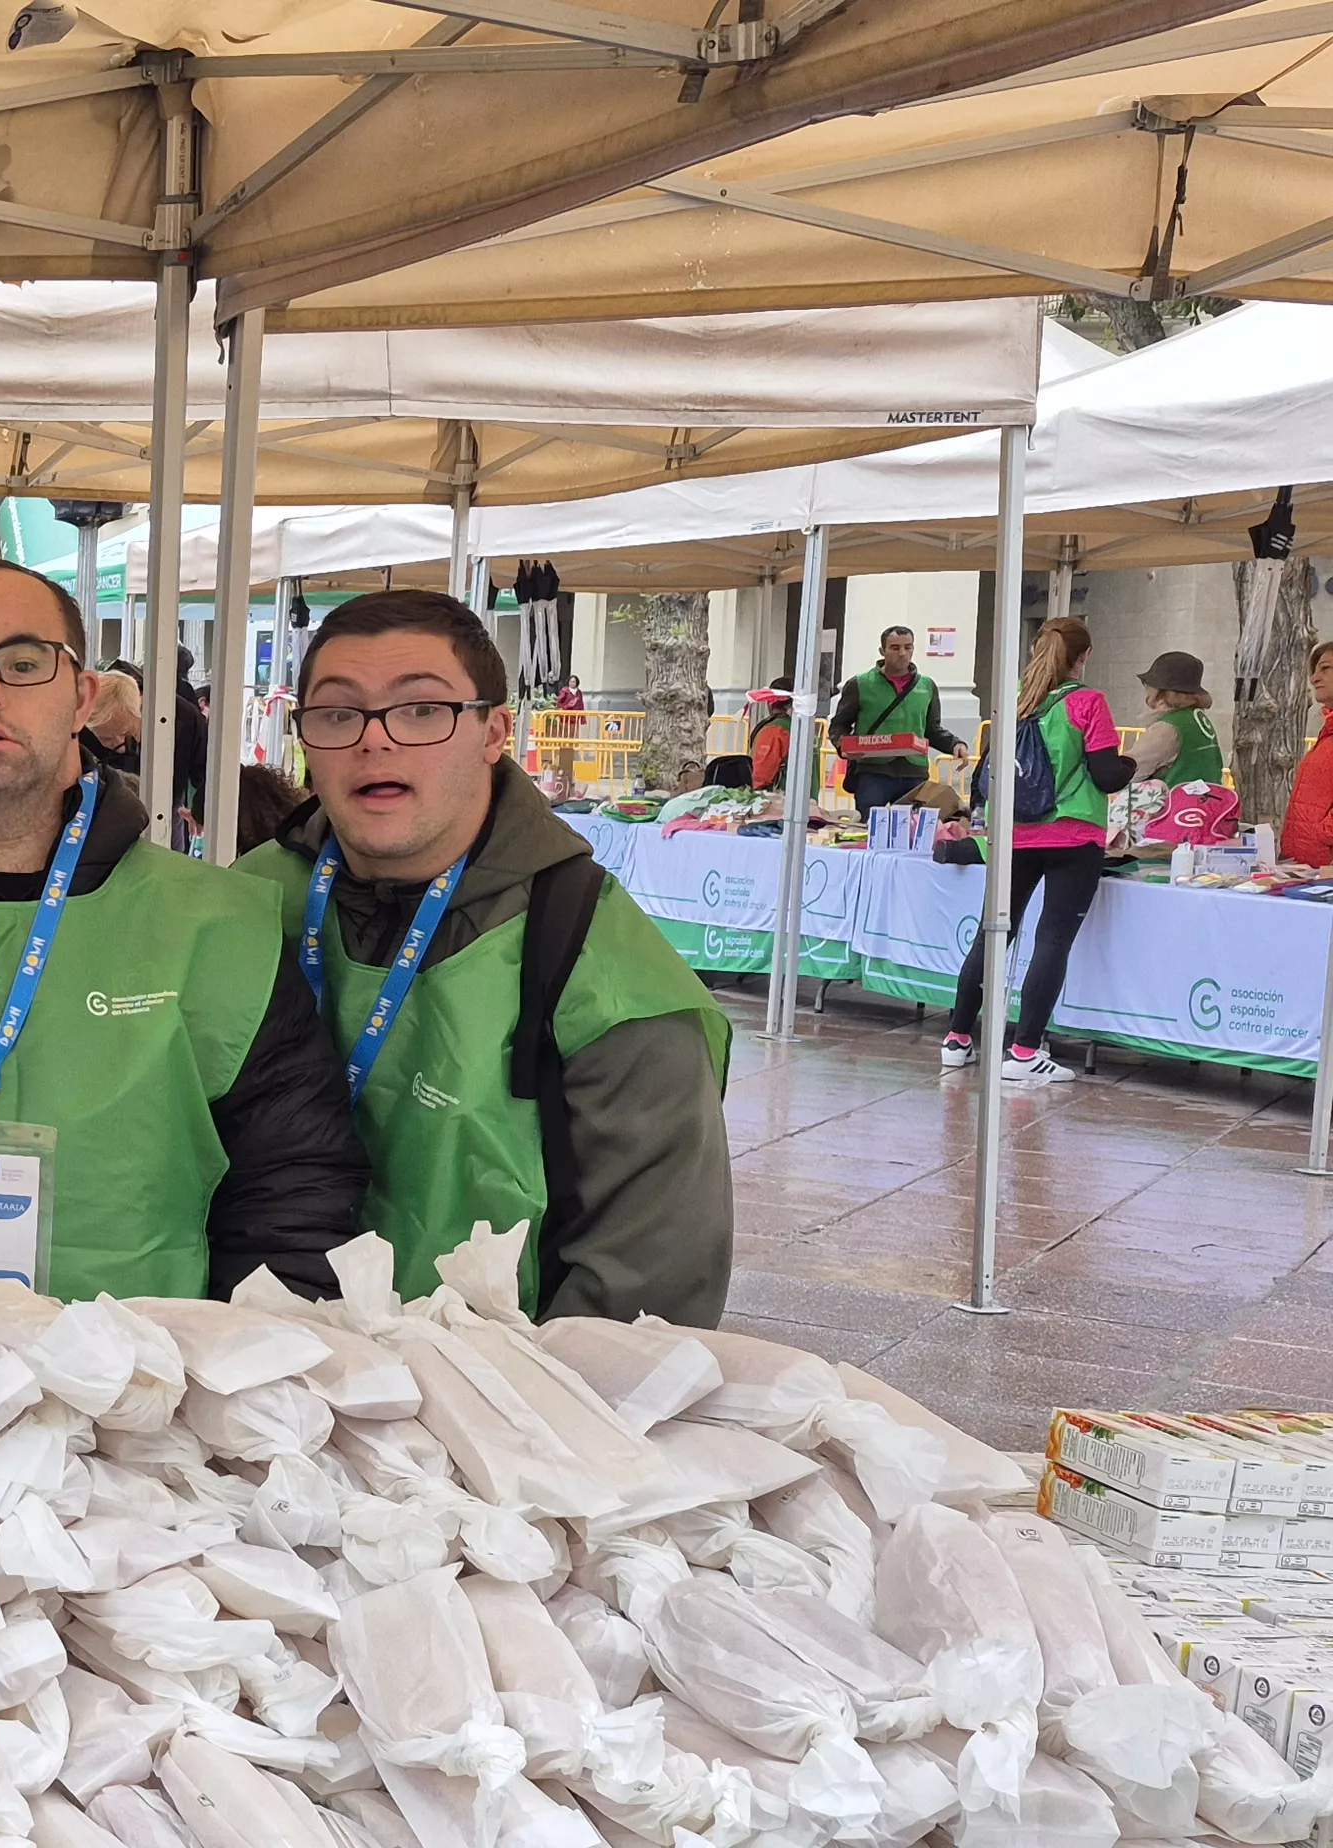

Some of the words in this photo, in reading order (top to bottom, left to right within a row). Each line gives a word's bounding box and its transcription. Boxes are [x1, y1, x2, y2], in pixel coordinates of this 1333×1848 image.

[886, 411, 981, 424] MASTERTENT
[45, 869, 67, 907] DOWN
[23, 936, 46, 976] DOWN
[397, 928, 425, 968] DOWN
[1230, 1004, 1276, 1018] española
[1231, 987, 1284, 1004] asociación
[0, 1006, 23, 1047] DOWN
[366, 997, 393, 1036] DOWN
[1228, 1020, 1261, 1033] contra
[1263, 1023, 1273, 1036] el
[1274, 1024, 1309, 1039] cáncer
